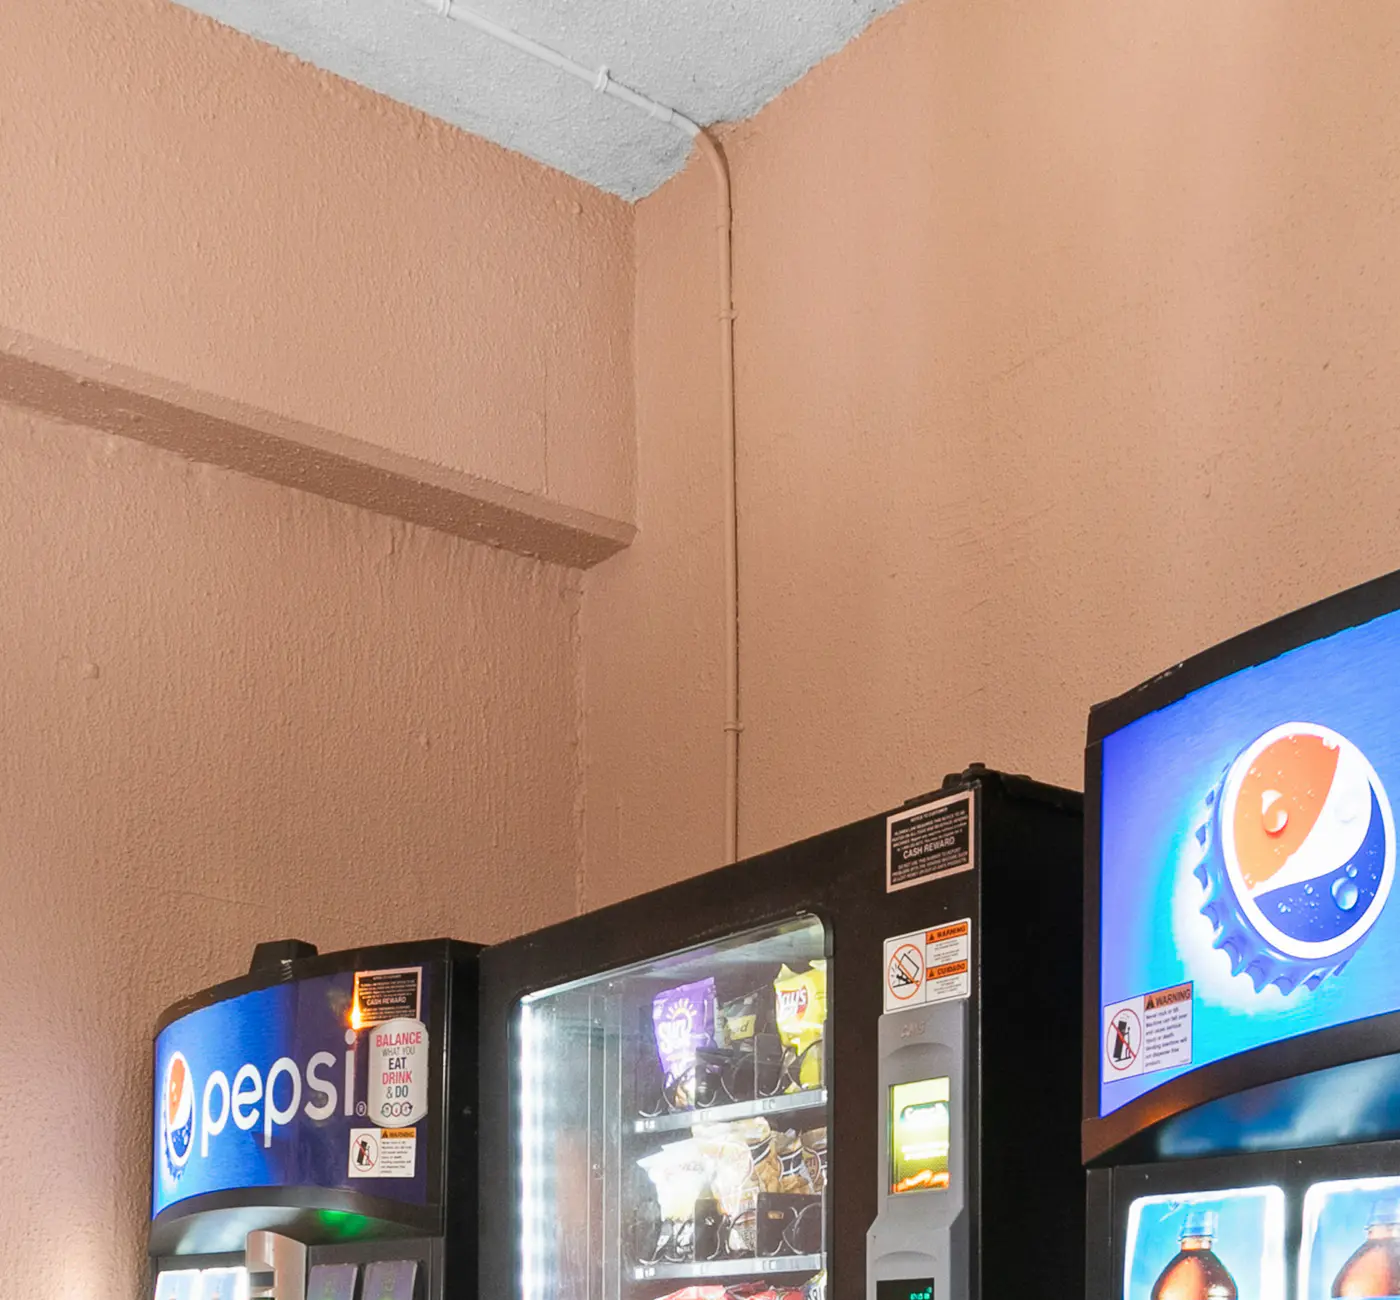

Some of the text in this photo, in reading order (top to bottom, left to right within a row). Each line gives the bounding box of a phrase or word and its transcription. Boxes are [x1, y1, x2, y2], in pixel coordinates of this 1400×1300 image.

[903, 846, 923, 859] CASH
[923, 836, 955, 853] REWARD
[1156, 990, 1190, 1006] WARNING
[376, 1031, 422, 1048] BALANCE
[382, 1045, 416, 1056] WHAT YOU
[388, 1056, 407, 1070] EAT
[382, 1070, 413, 1085] DRINK
[200, 1028, 354, 1157] pepsi
[386, 1085, 409, 1099] & DO
